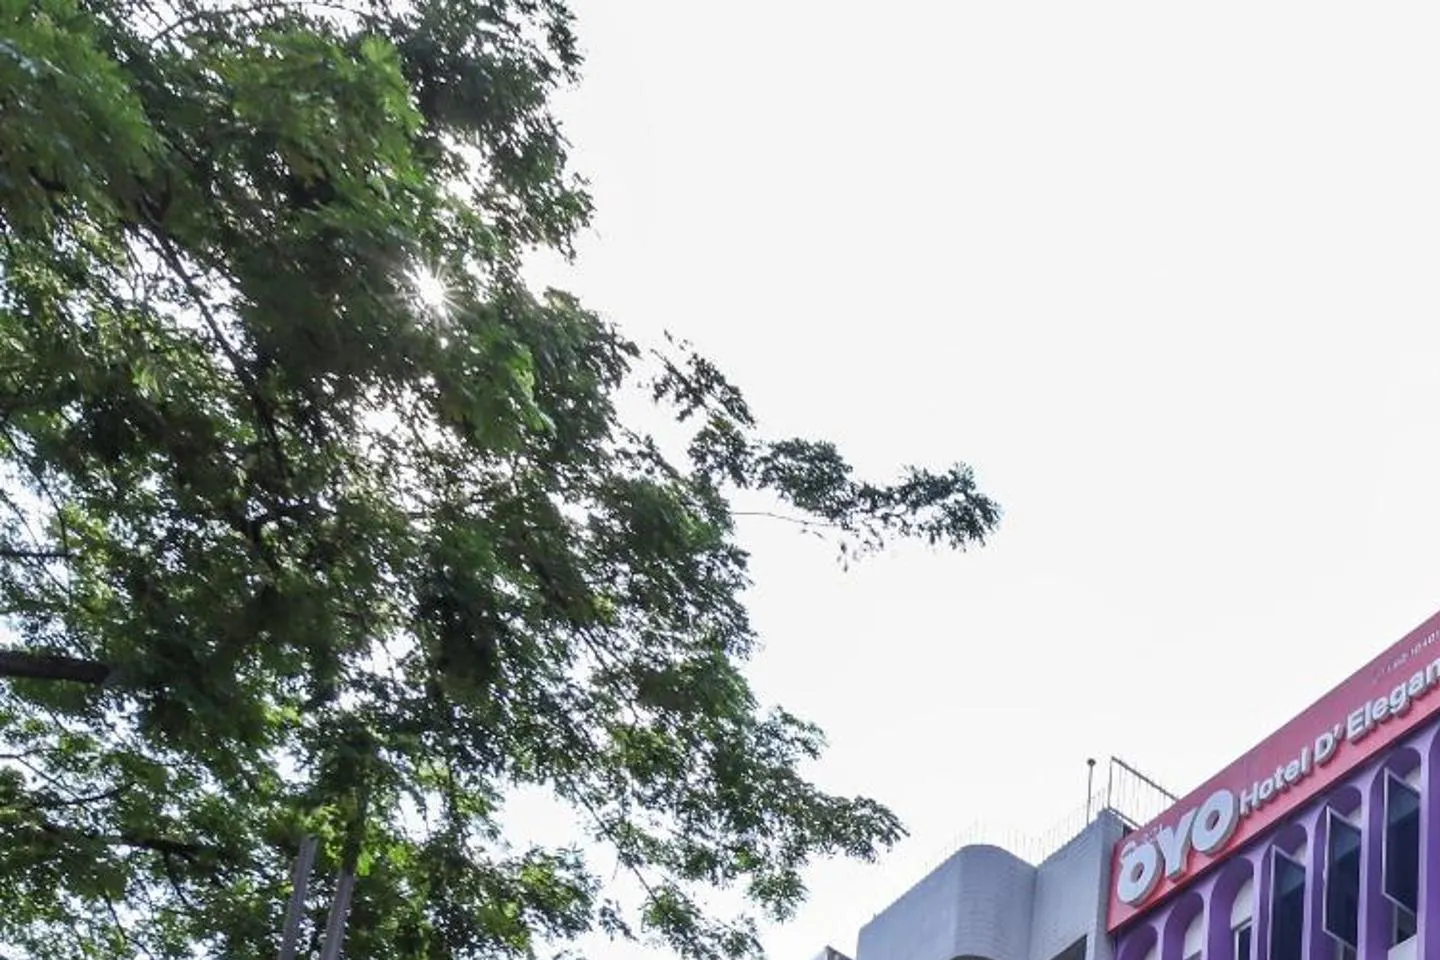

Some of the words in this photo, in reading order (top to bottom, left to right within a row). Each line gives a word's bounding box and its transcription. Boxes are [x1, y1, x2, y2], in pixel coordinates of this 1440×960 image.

[1117, 788, 1238, 905] OYO
[1239, 746, 1312, 816] Hotel
[1313, 722, 1345, 765] D'
